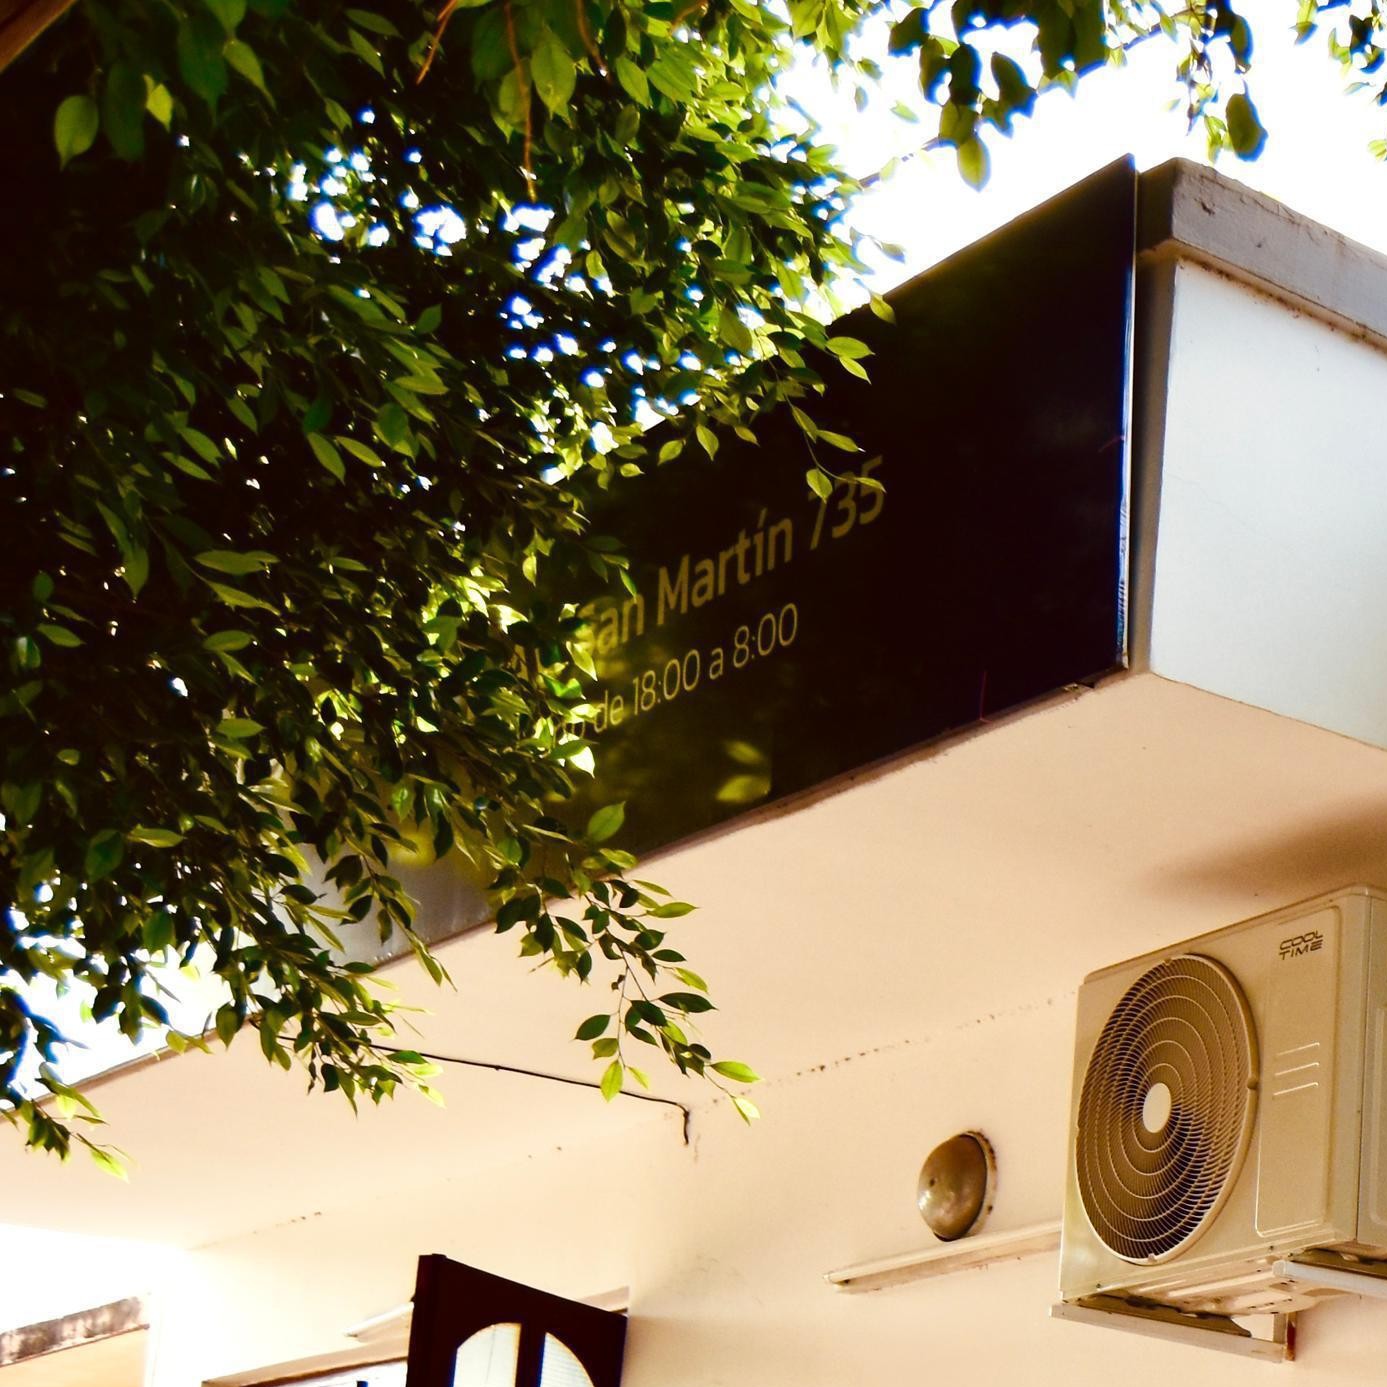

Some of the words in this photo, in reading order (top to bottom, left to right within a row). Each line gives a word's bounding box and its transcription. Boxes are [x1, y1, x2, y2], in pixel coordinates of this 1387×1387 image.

[656, 508, 793, 626] Martín
[808, 455, 884, 550] 735
[593, 688, 625, 734] de
[632, 648, 701, 716] 18:00
[708, 646, 725, 680] a
[731, 602, 800, 668] 8:00
[1279, 929, 1324, 951] COOL
[1279, 939, 1324, 961] TIME
